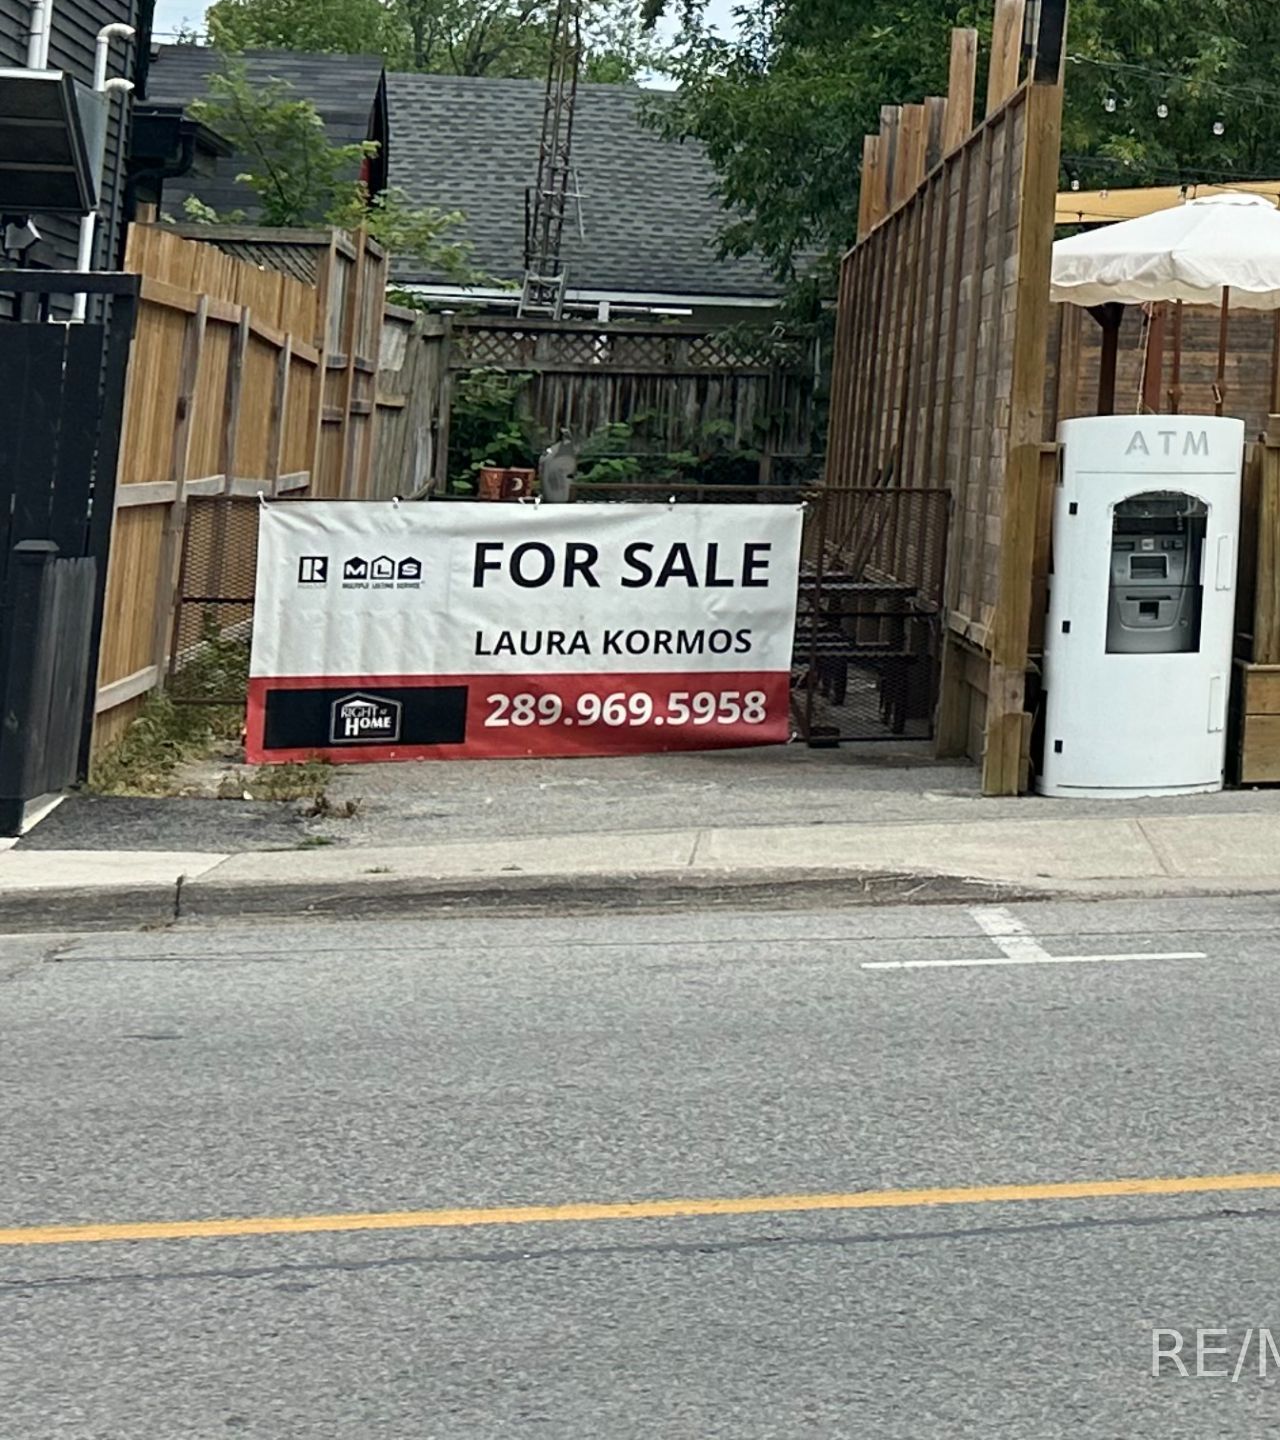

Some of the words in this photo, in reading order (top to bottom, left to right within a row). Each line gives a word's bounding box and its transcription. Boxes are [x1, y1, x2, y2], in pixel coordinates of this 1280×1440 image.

[1125, 430, 1210, 457] ATM
[473, 541, 601, 588] FOR
[621, 541, 772, 588] SALE
[475, 629, 591, 656] LAURA
[603, 628, 752, 655] KORMOS
[484, 691, 767, 728] 289.969.5958
[345, 716, 392, 736] HOME
